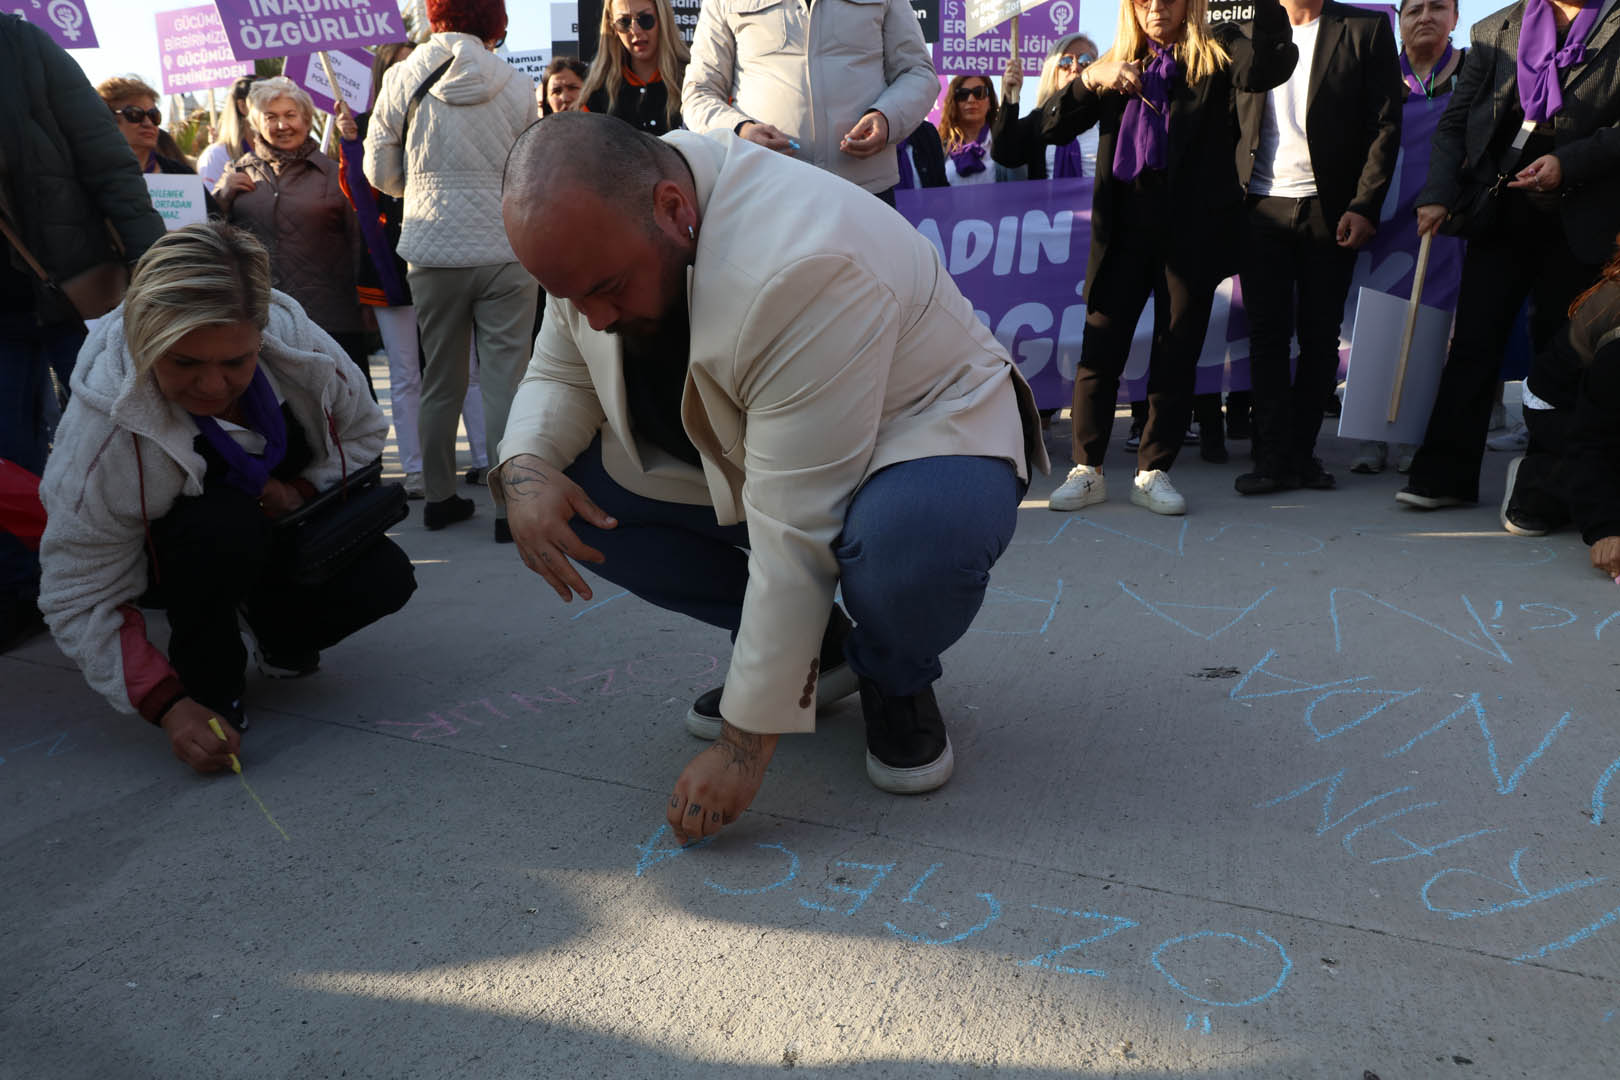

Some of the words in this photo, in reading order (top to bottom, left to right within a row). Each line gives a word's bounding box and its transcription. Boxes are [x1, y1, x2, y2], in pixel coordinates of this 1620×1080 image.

[239, 7, 396, 50] ÖZGÜRLÜK
[507, 55, 542, 64] Namus
[942, 57, 994, 73] KARŞI
